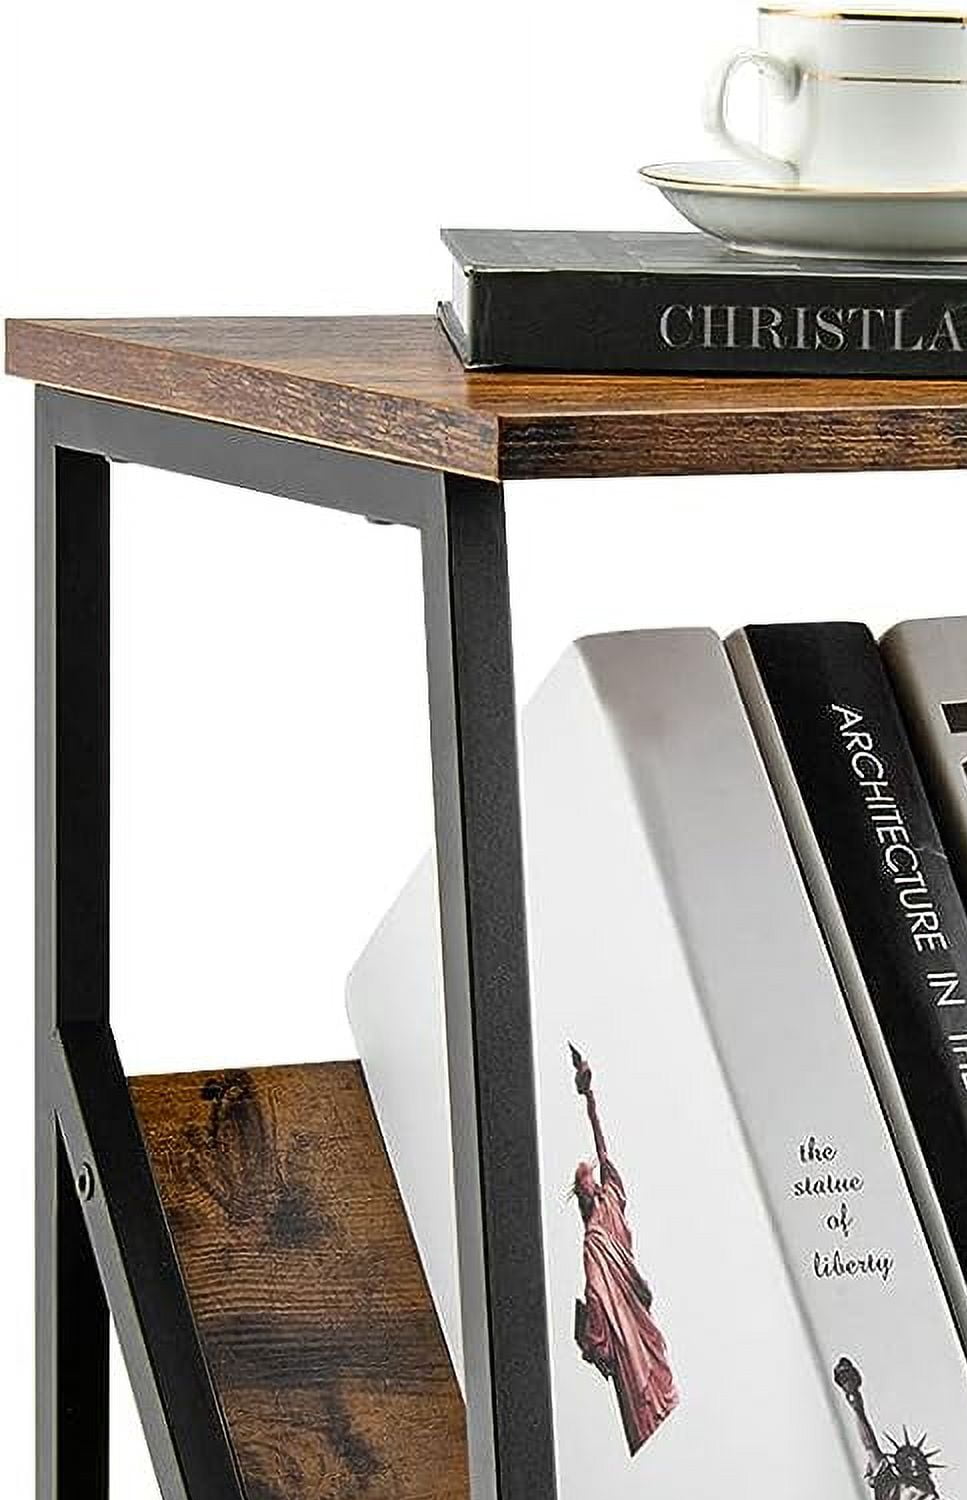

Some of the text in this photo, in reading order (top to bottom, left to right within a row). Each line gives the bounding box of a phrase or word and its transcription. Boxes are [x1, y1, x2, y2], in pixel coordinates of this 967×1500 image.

[831, 702, 948, 953] ARCHITECTURE
[927, 972, 965, 1007] IN
[799, 1136, 837, 1163] the
[793, 1174, 865, 1197] statue
[826, 1202, 853, 1238] of
[813, 1250, 894, 1281] liberty
